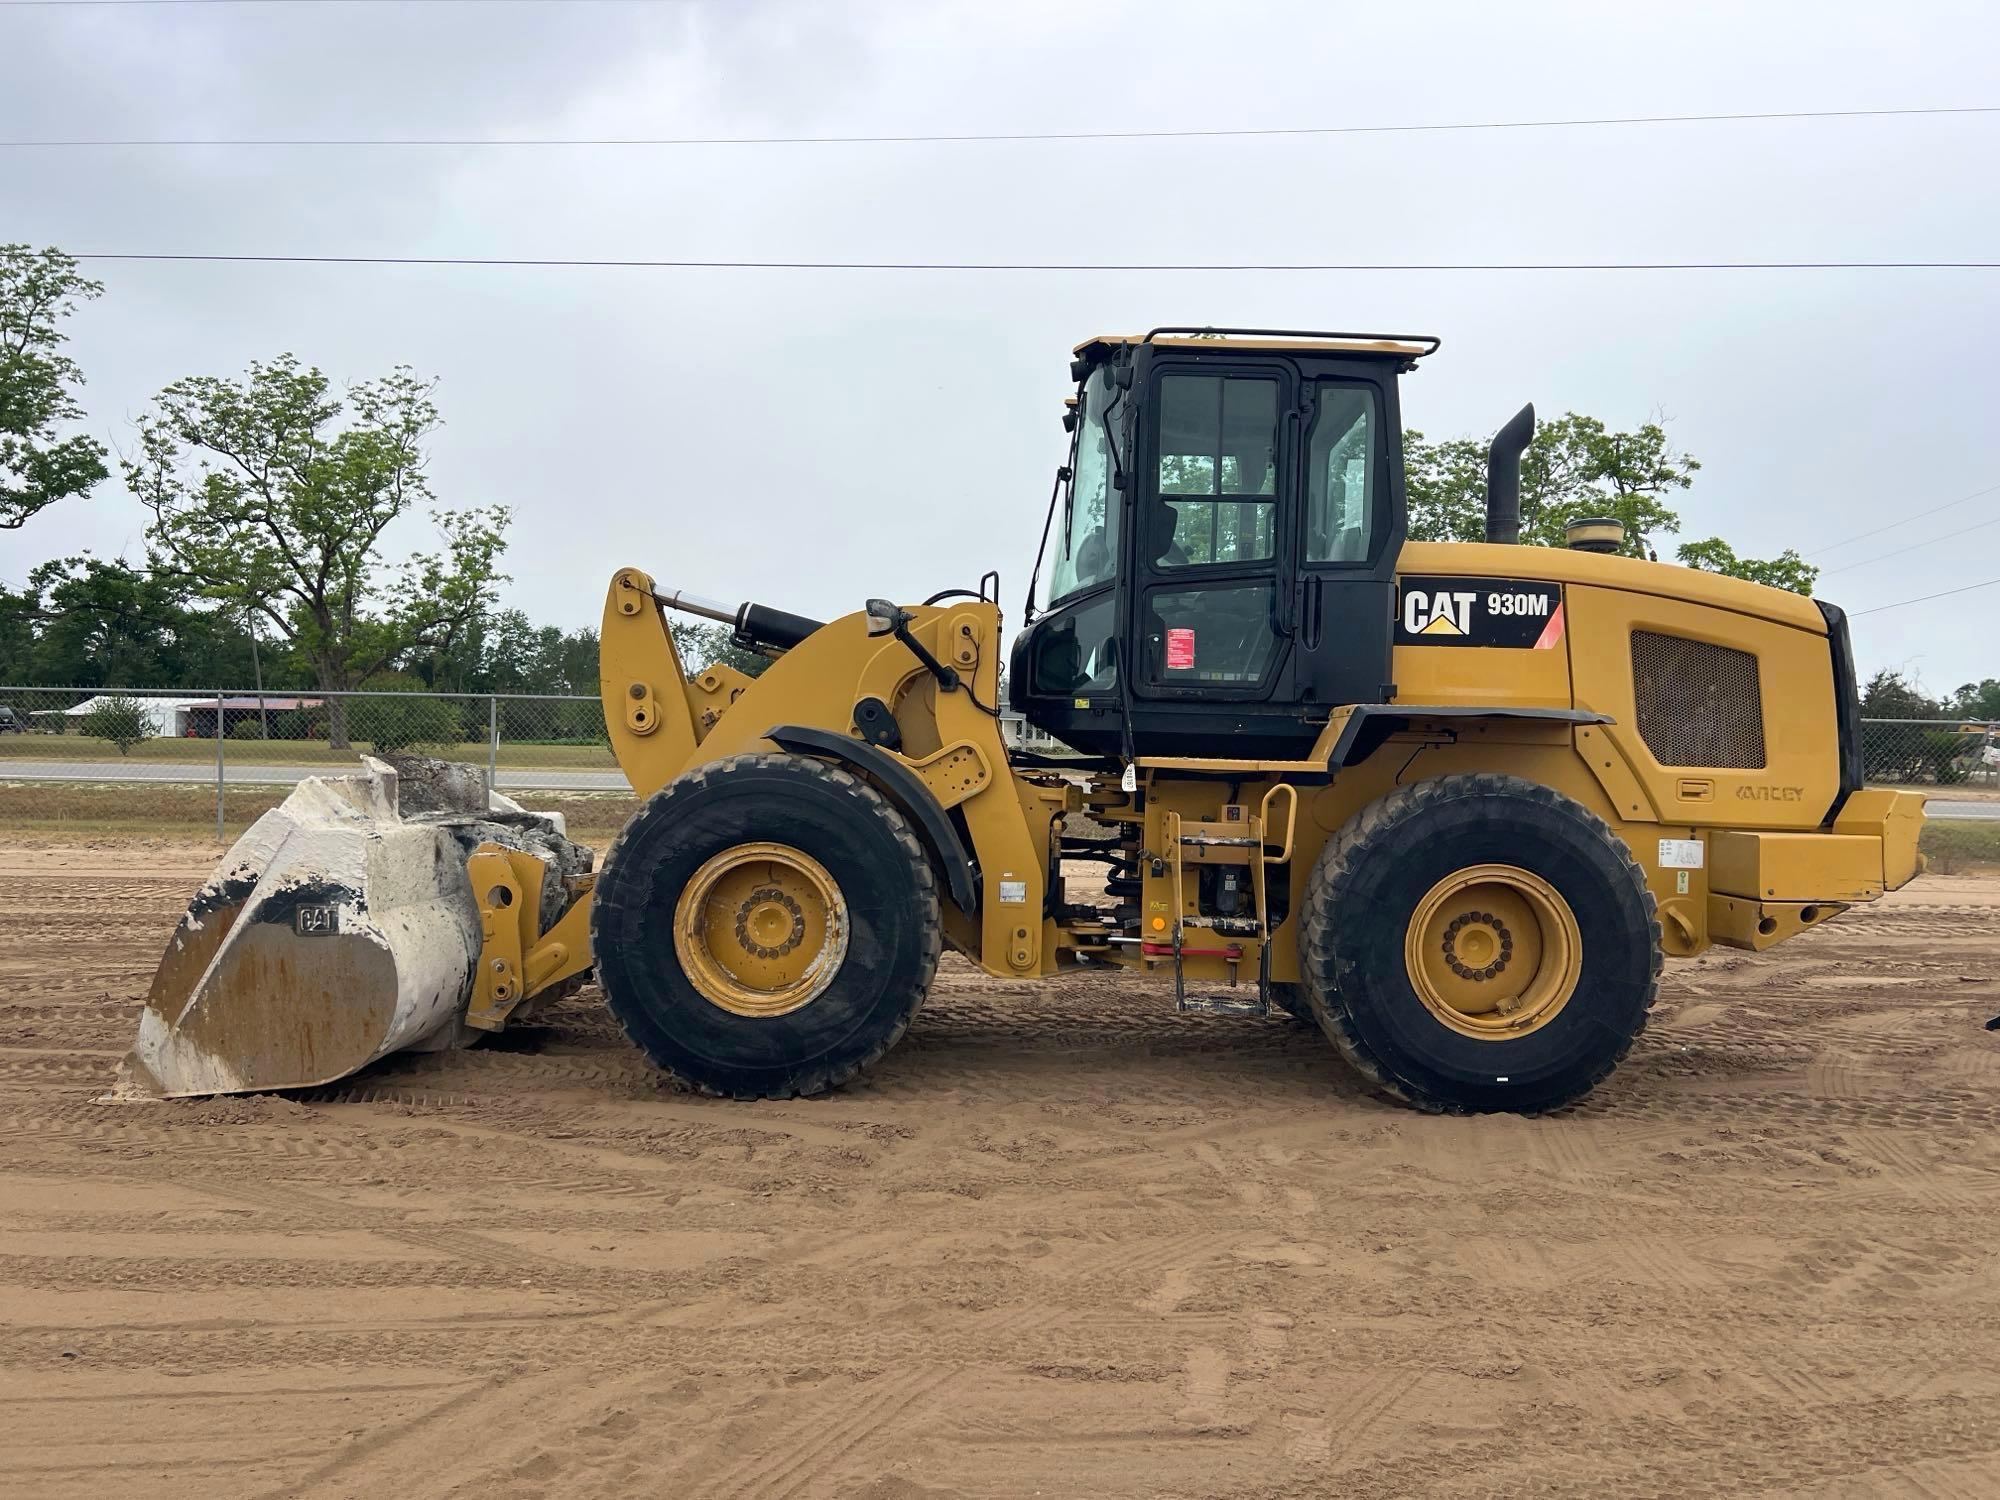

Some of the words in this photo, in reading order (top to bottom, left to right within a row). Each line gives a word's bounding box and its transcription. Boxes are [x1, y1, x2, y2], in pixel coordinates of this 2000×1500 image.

[1404, 591, 1477, 635] CAT
[1487, 593, 1548, 616] 930M
[300, 909, 338, 931] CAT
